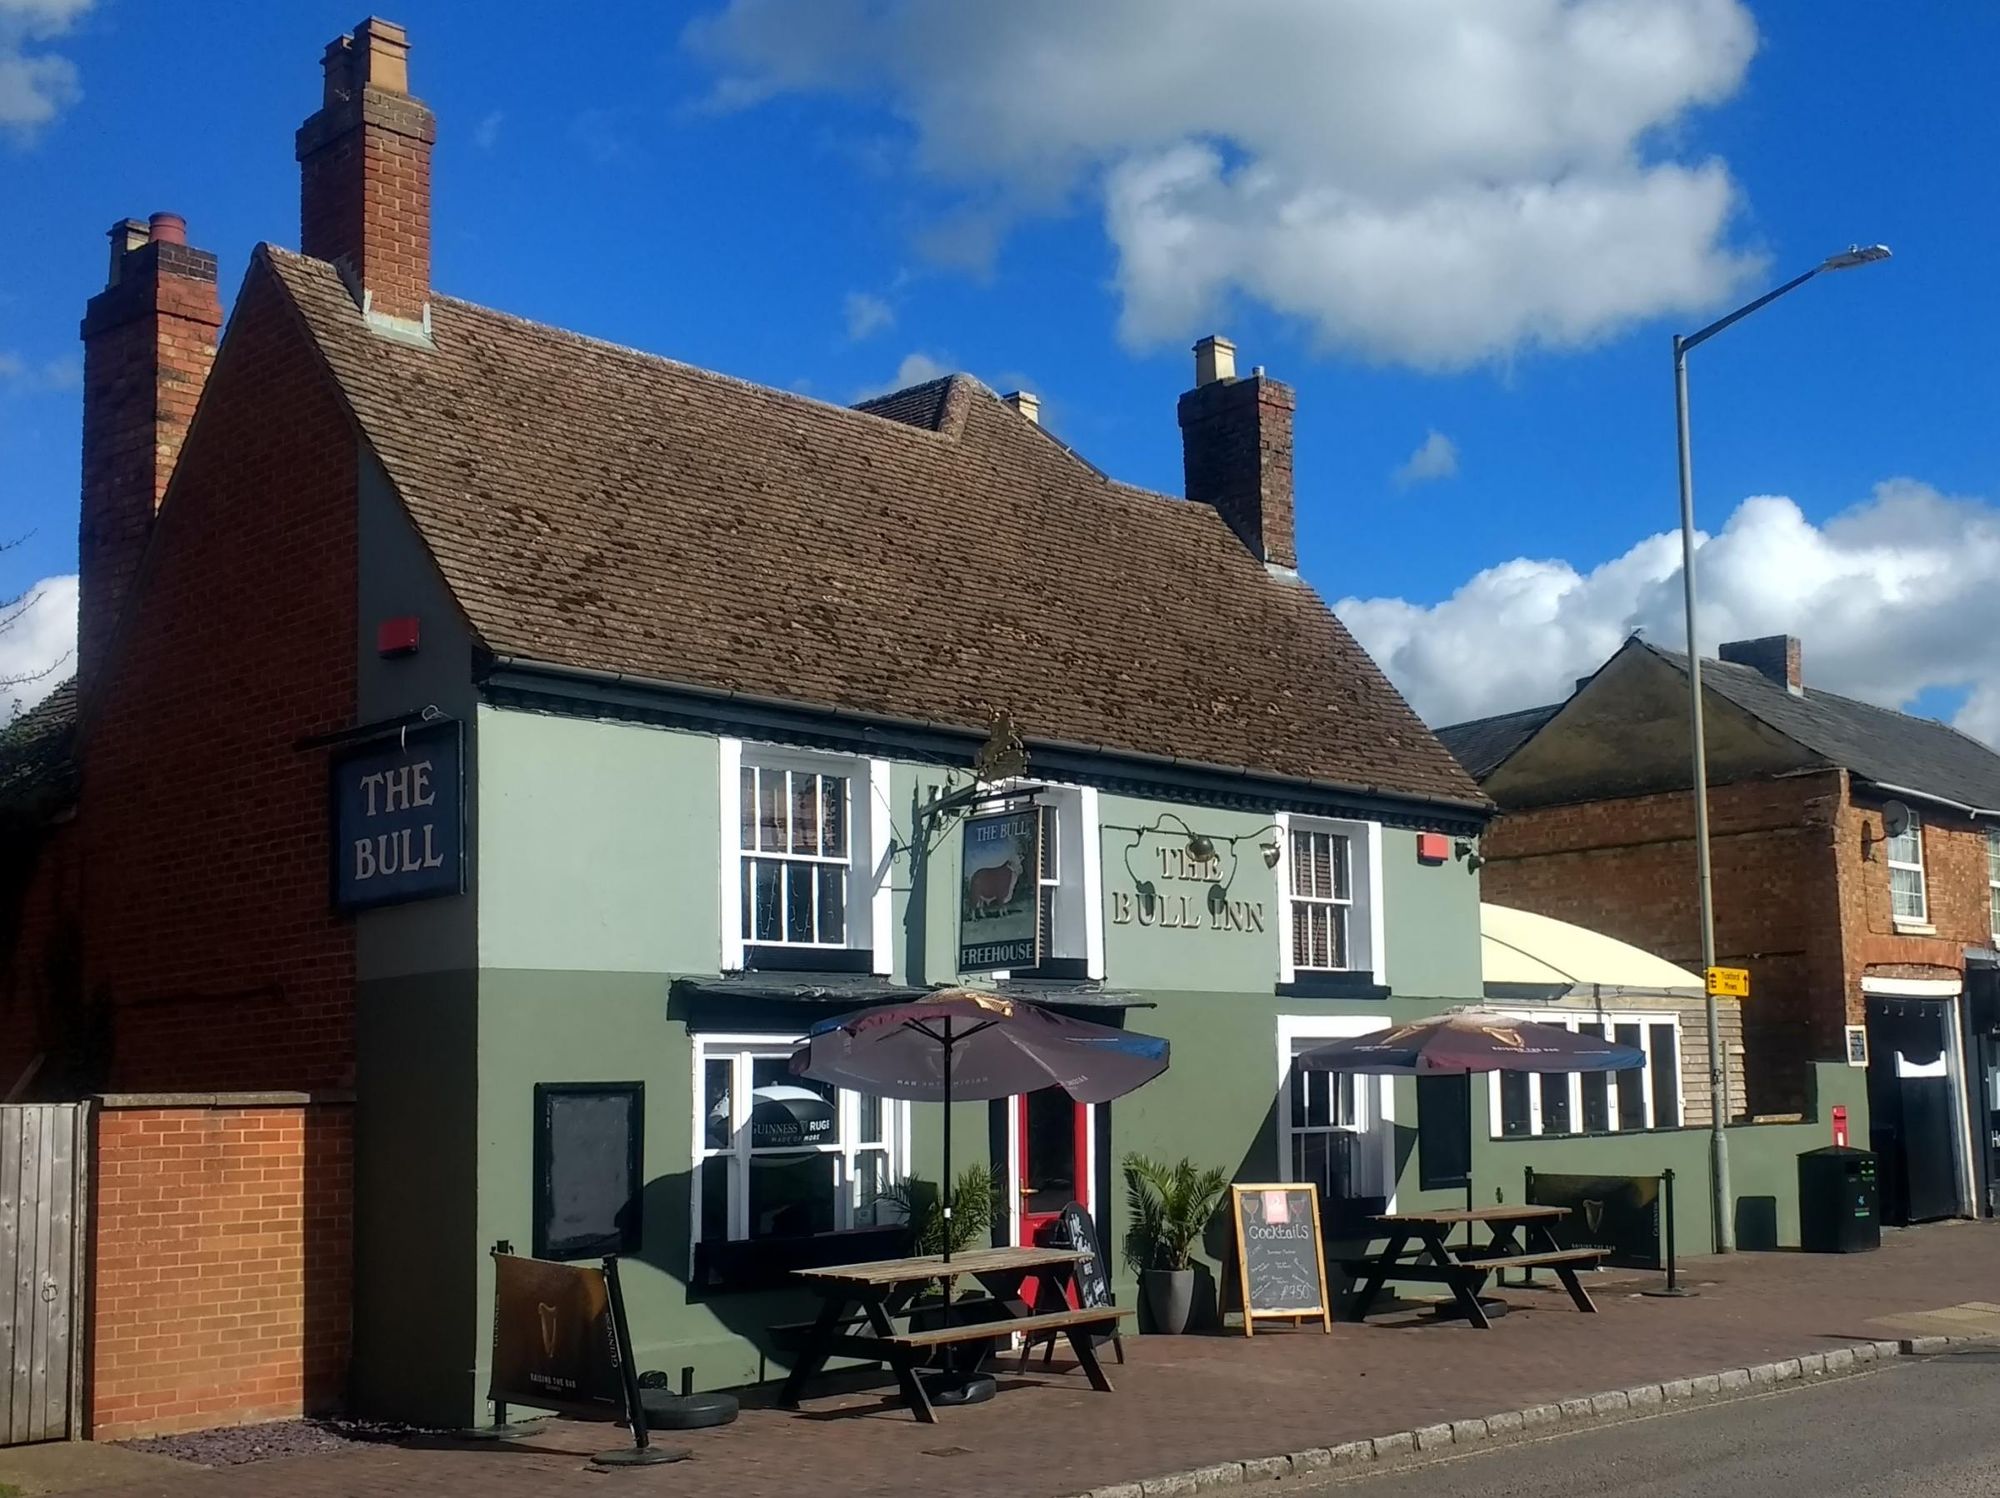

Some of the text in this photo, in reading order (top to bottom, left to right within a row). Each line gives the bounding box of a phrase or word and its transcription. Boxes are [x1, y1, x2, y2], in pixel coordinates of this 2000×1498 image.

[360, 760, 435, 816] THE
[976, 821, 1027, 842] THE BULL
[354, 823, 444, 880] BULL
[1156, 846, 1224, 883] THE
[1112, 890, 1265, 933] BULL INN
[962, 943, 1034, 965] FREEHOUSE
[803, 1133, 820, 1141] MORE
